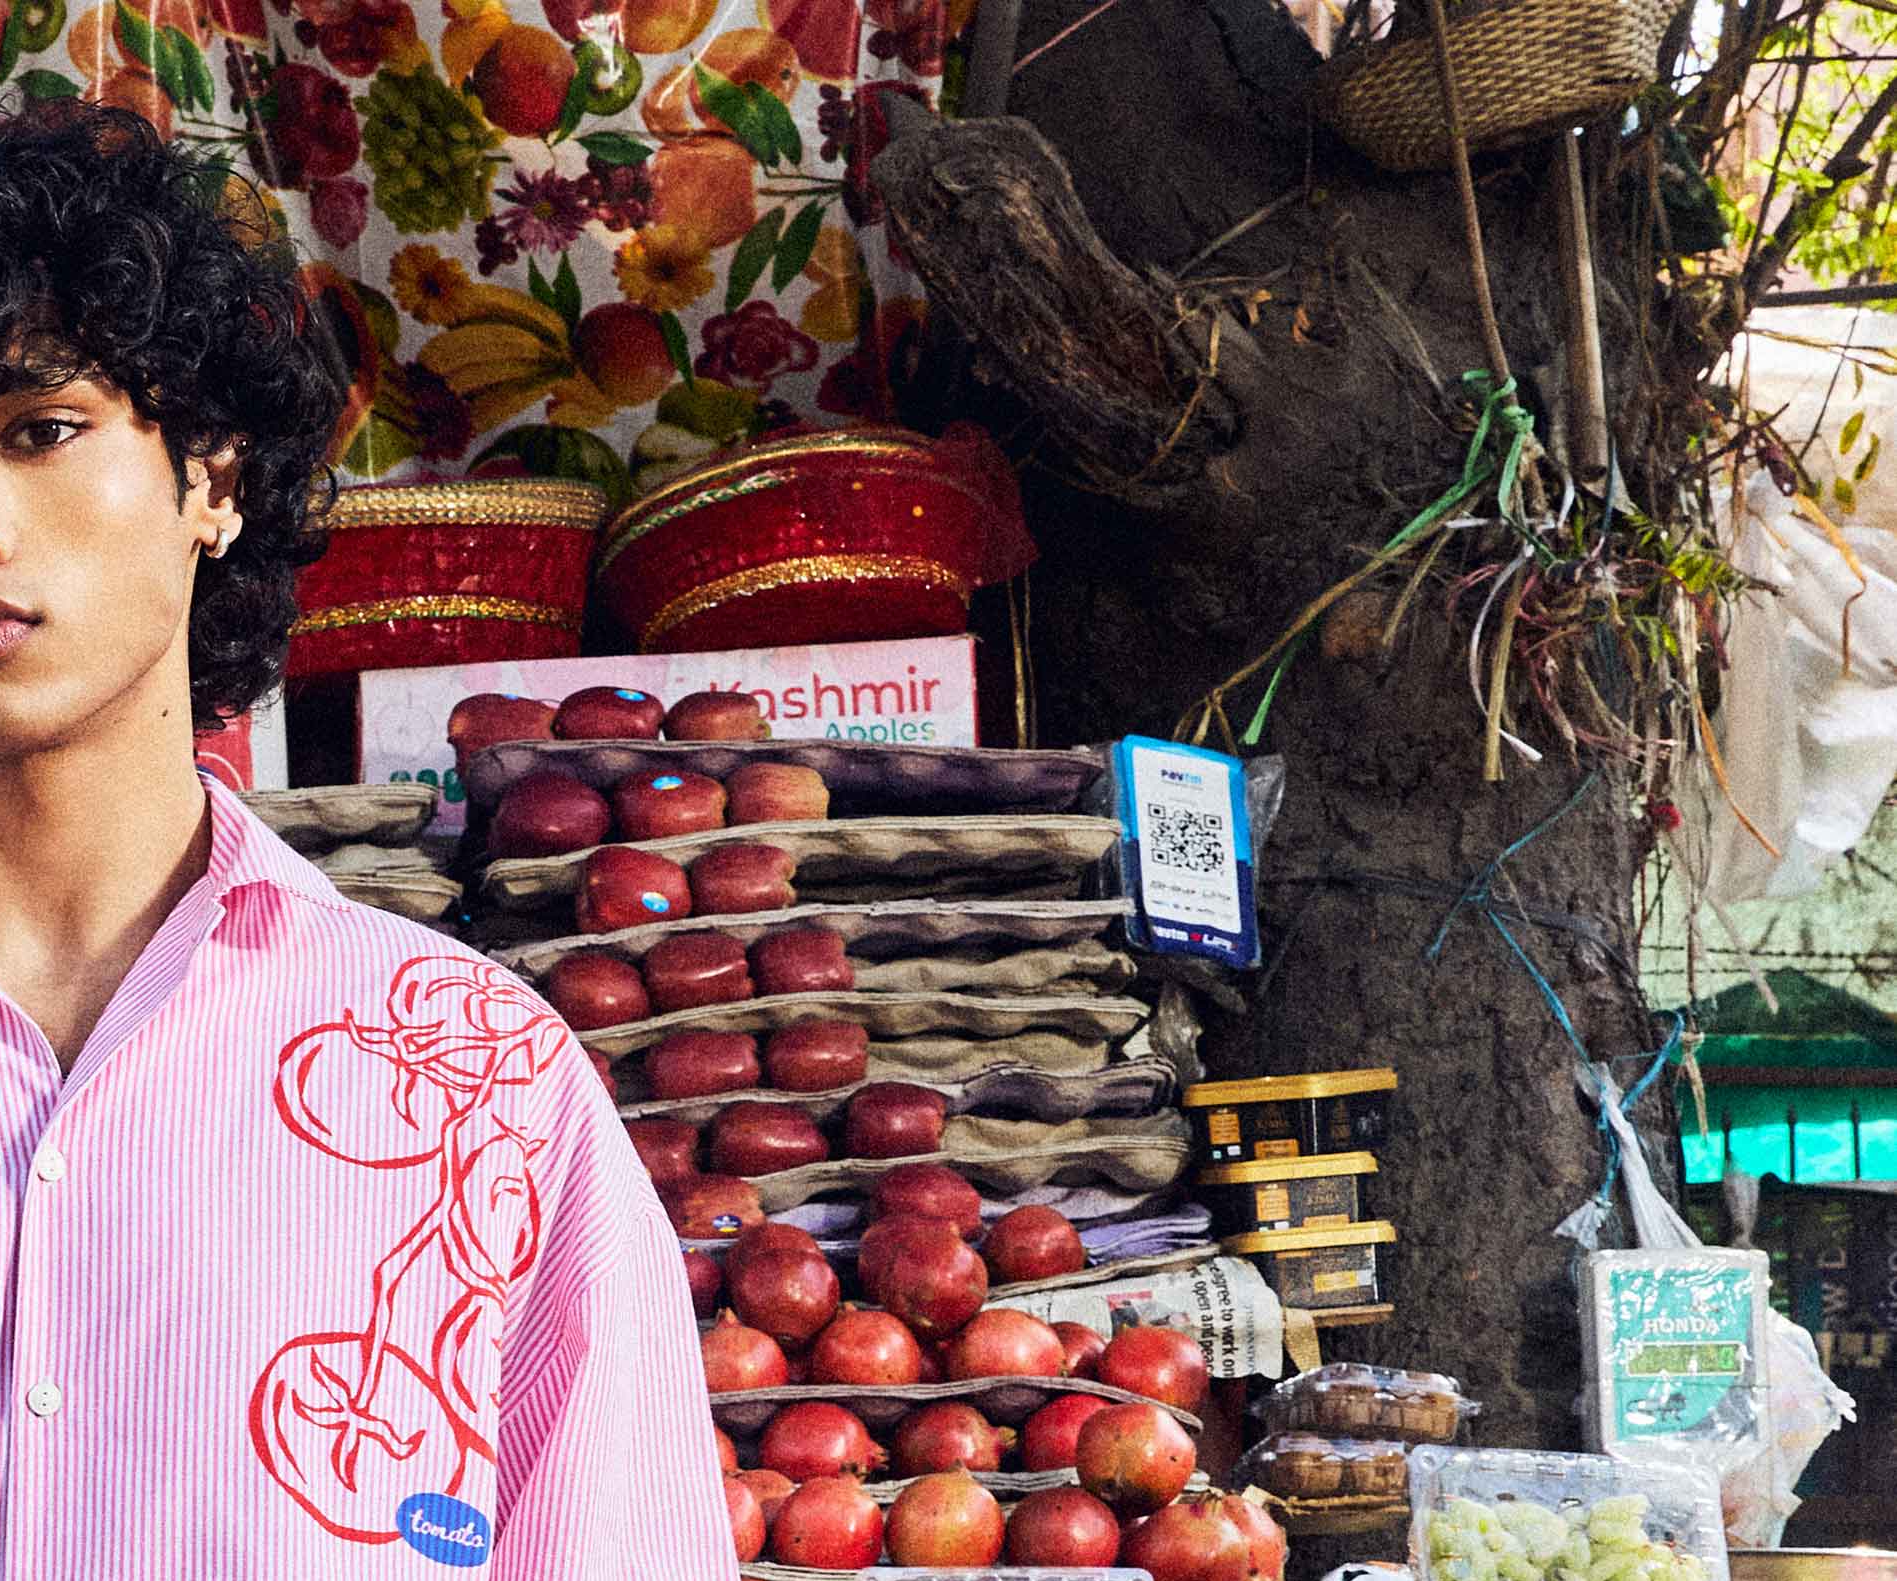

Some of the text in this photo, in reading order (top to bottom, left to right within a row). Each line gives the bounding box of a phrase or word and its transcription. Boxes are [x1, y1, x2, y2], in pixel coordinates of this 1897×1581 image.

[1192, 1281, 1218, 1338] open and
[1222, 1308, 1238, 1377] to work on
[410, 1509, 485, 1548] tomato
